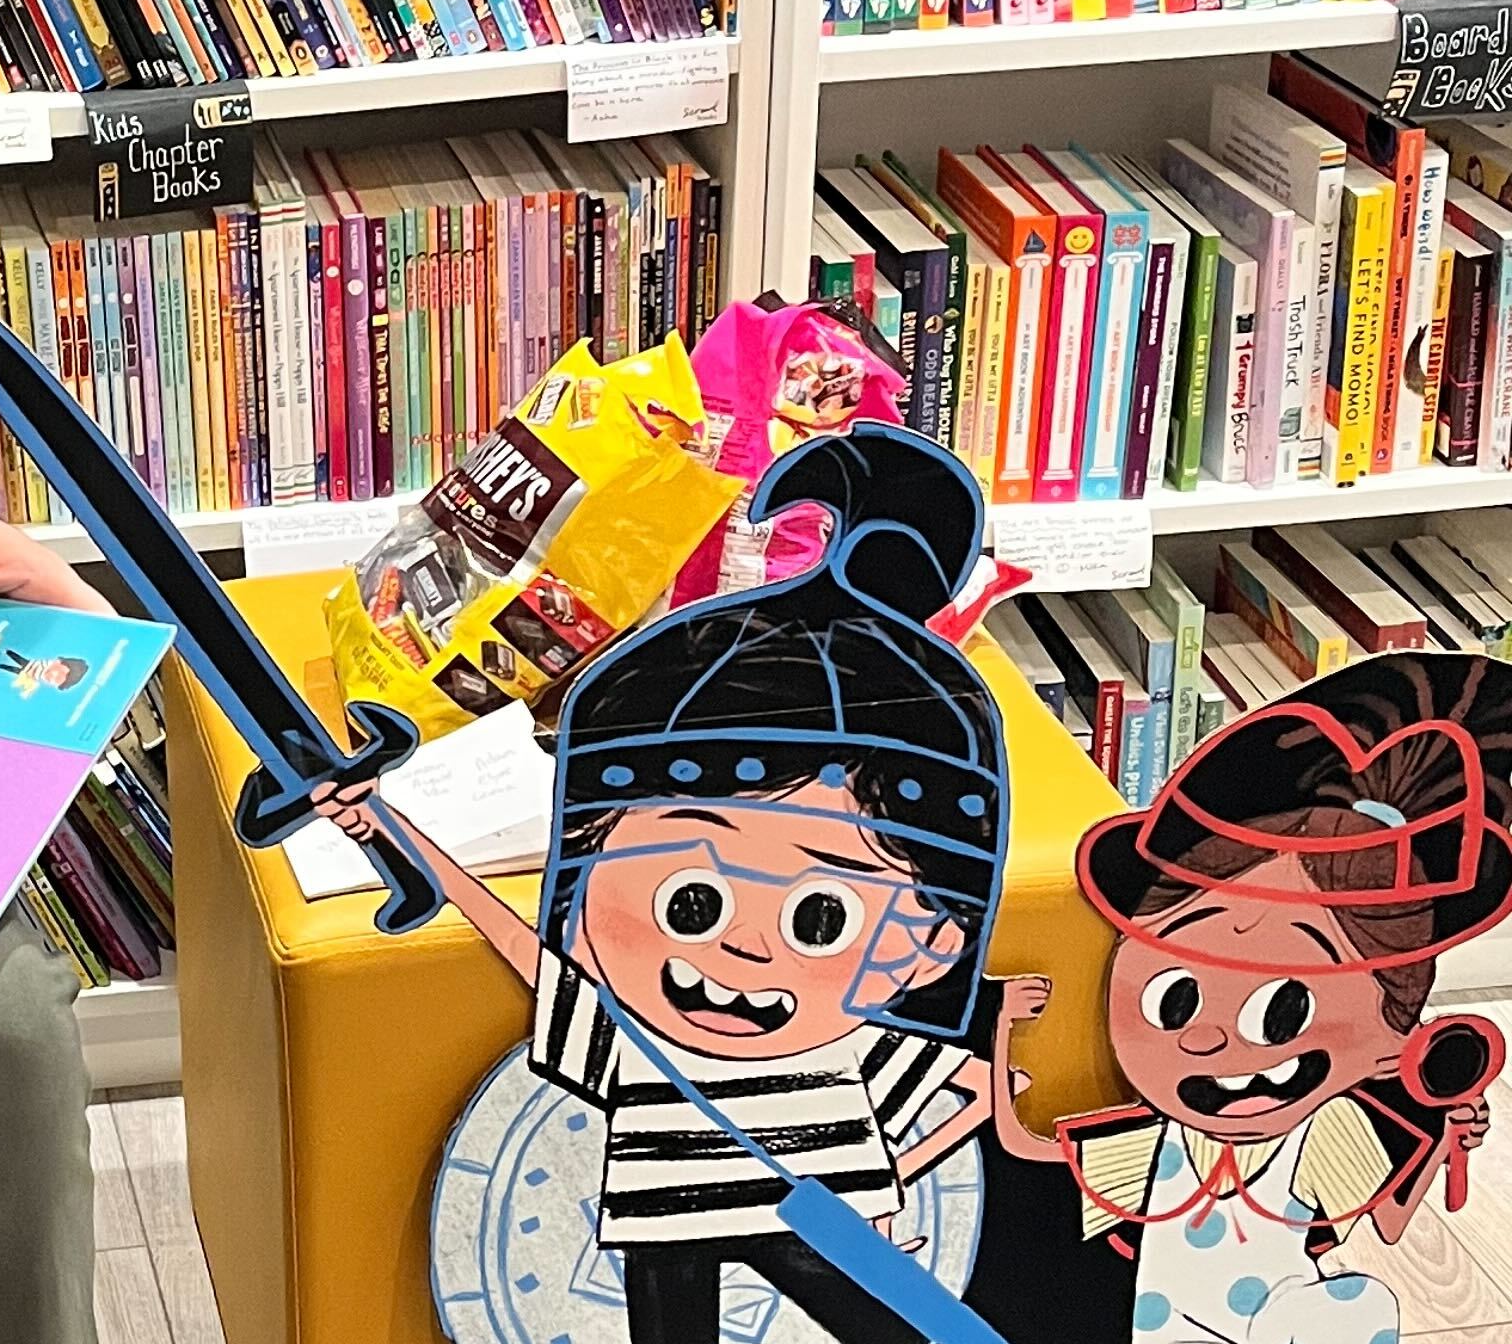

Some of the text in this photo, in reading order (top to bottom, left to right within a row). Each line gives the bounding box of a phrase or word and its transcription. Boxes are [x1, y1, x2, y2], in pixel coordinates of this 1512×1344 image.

[1400, 7, 1510, 65] Board
[88, 109, 145, 146] Kids
[128, 122, 225, 173] Chapter
[152, 170, 222, 203] Books
[1284, 294, 1307, 388] Trash Truck
[1344, 257, 1372, 428] LET'S FIND MOMO!
[1421, 316, 1446, 423] THE CARROT SEED
[921, 349, 938, 433] ODD BEASTS
[1234, 350, 1251, 411] Grumpy
